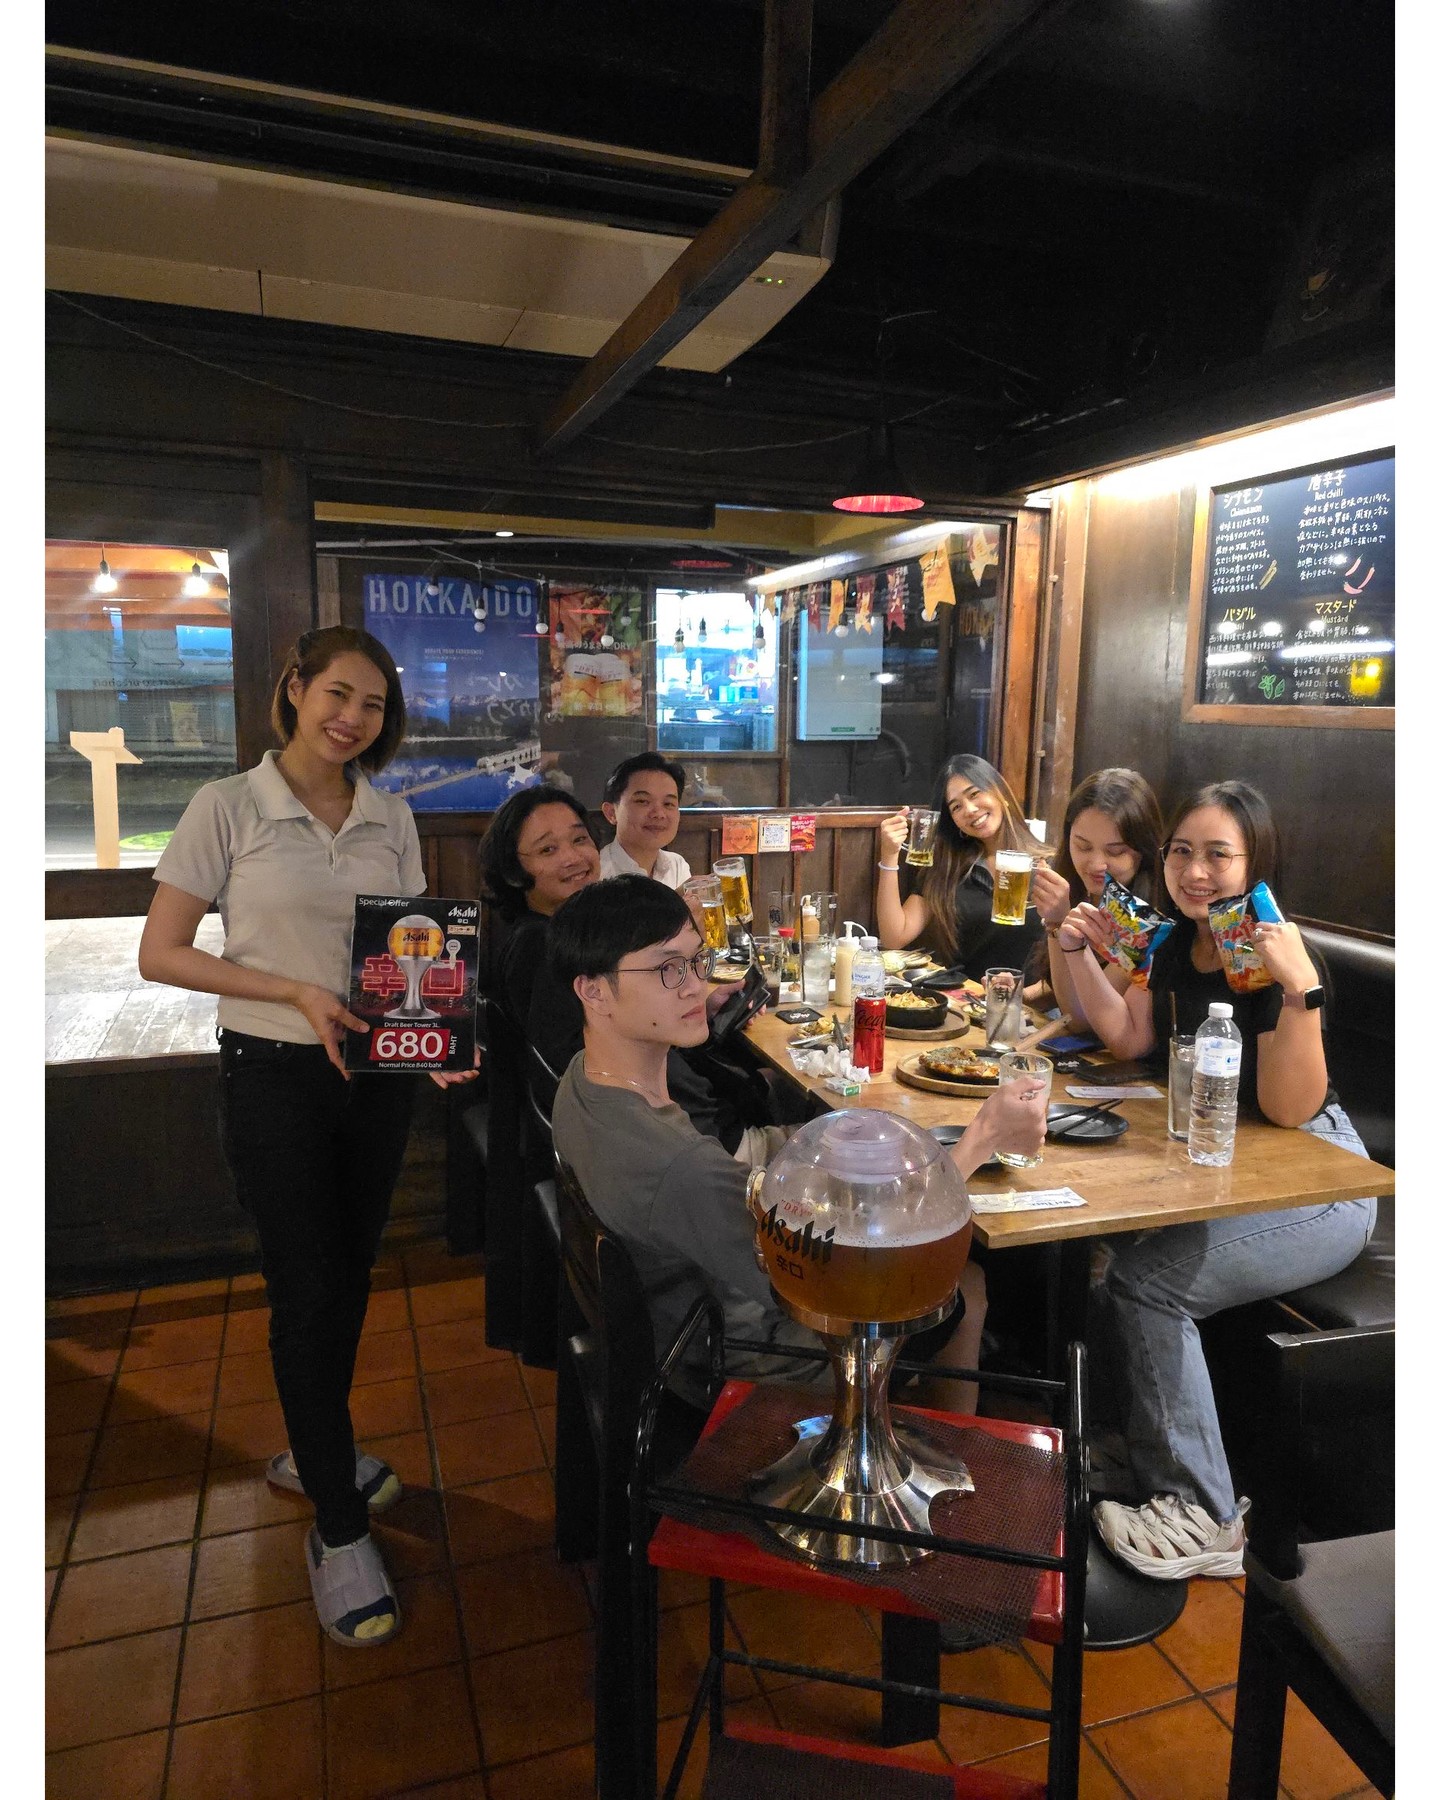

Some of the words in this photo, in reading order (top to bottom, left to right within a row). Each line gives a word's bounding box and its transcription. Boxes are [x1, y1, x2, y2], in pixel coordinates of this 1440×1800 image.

[1307, 470, 1346, 492] 唐辛子
[1223, 487, 1264, 509] シナモン
[368, 577, 534, 617] HOKKAIDO
[1223, 606, 1257, 622] バジル
[1314, 598, 1358, 615] マスタード
[358, 897, 387, 907] Special
[388, 899, 410, 908] Offer
[448, 905, 477, 918] Asahi
[402, 931, 430, 942] Asahi
[376, 1030, 443, 1059] 680
[448, 1035, 458, 1055] BAHT
[378, 1061, 400, 1069] Normal
[760, 1203, 837, 1264] Asahi
